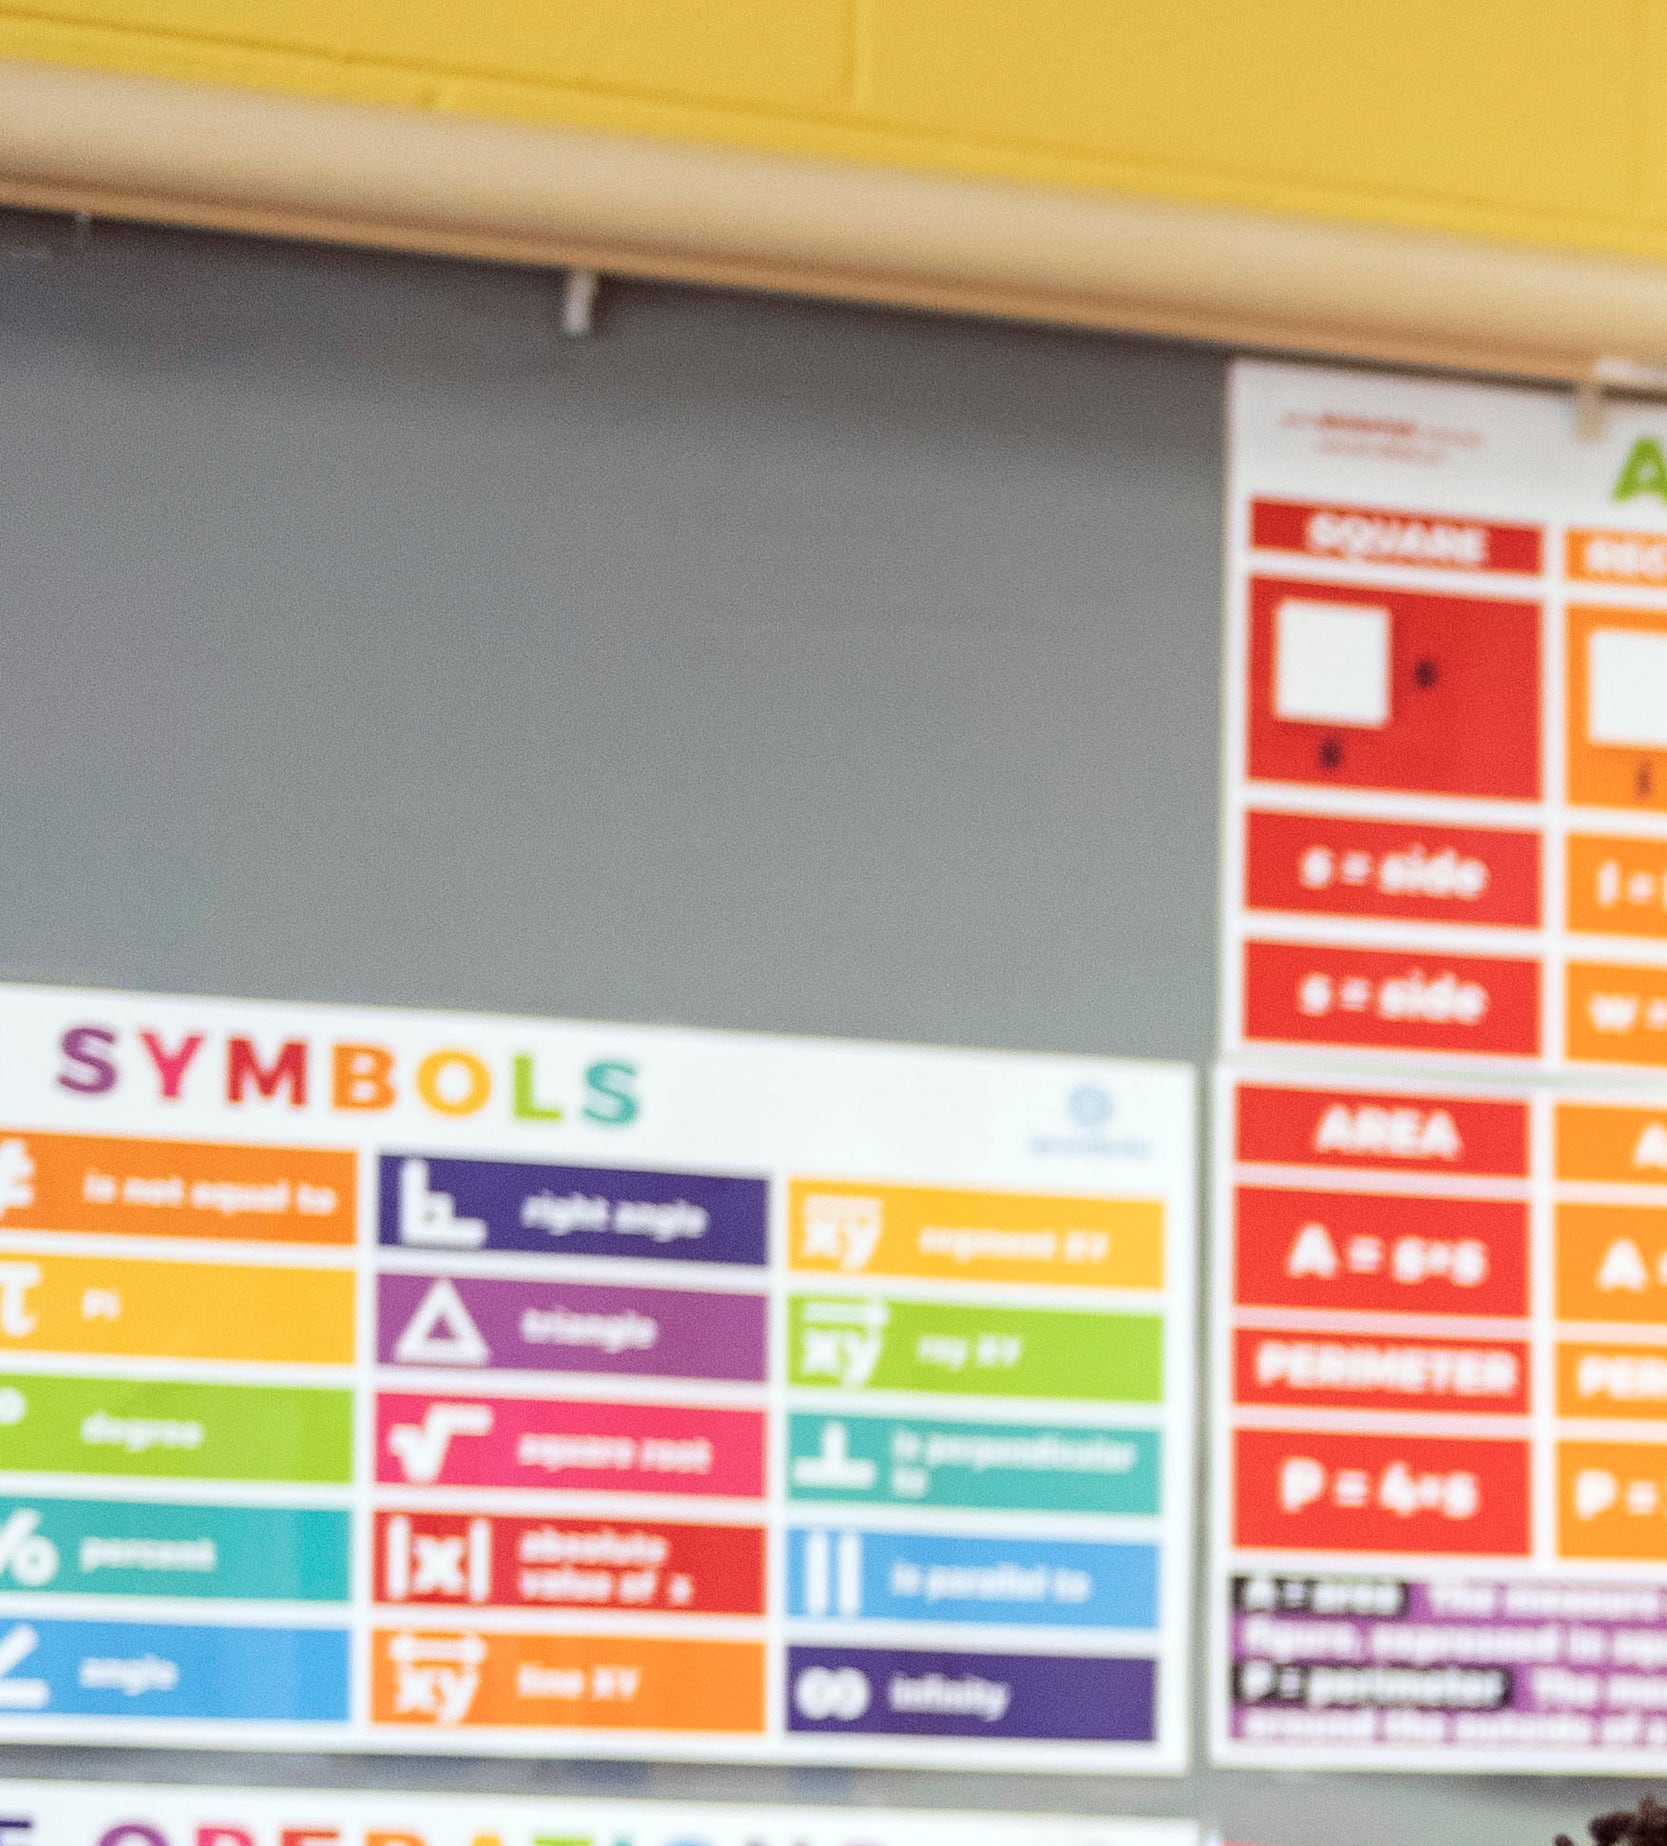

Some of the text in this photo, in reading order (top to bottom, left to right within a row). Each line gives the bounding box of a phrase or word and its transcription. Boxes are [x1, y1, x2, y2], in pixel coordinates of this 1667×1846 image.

[1305, 513, 1488, 564] SQUARE
[57, 1026, 640, 1126] SYMBOLS
[1316, 1106, 1460, 1161] AREA
[84, 1169, 116, 1202] is
[125, 1172, 182, 1207] not
[192, 1175, 289, 1217] equal
[523, 1195, 708, 1241] right angle
[1288, 1224, 1335, 1277] A
[1599, 1242, 1644, 1291] A
[1258, 1342, 1516, 1393] PERIMETER
[1281, 1460, 1325, 1509] P
[1576, 1472, 1620, 1518] P
